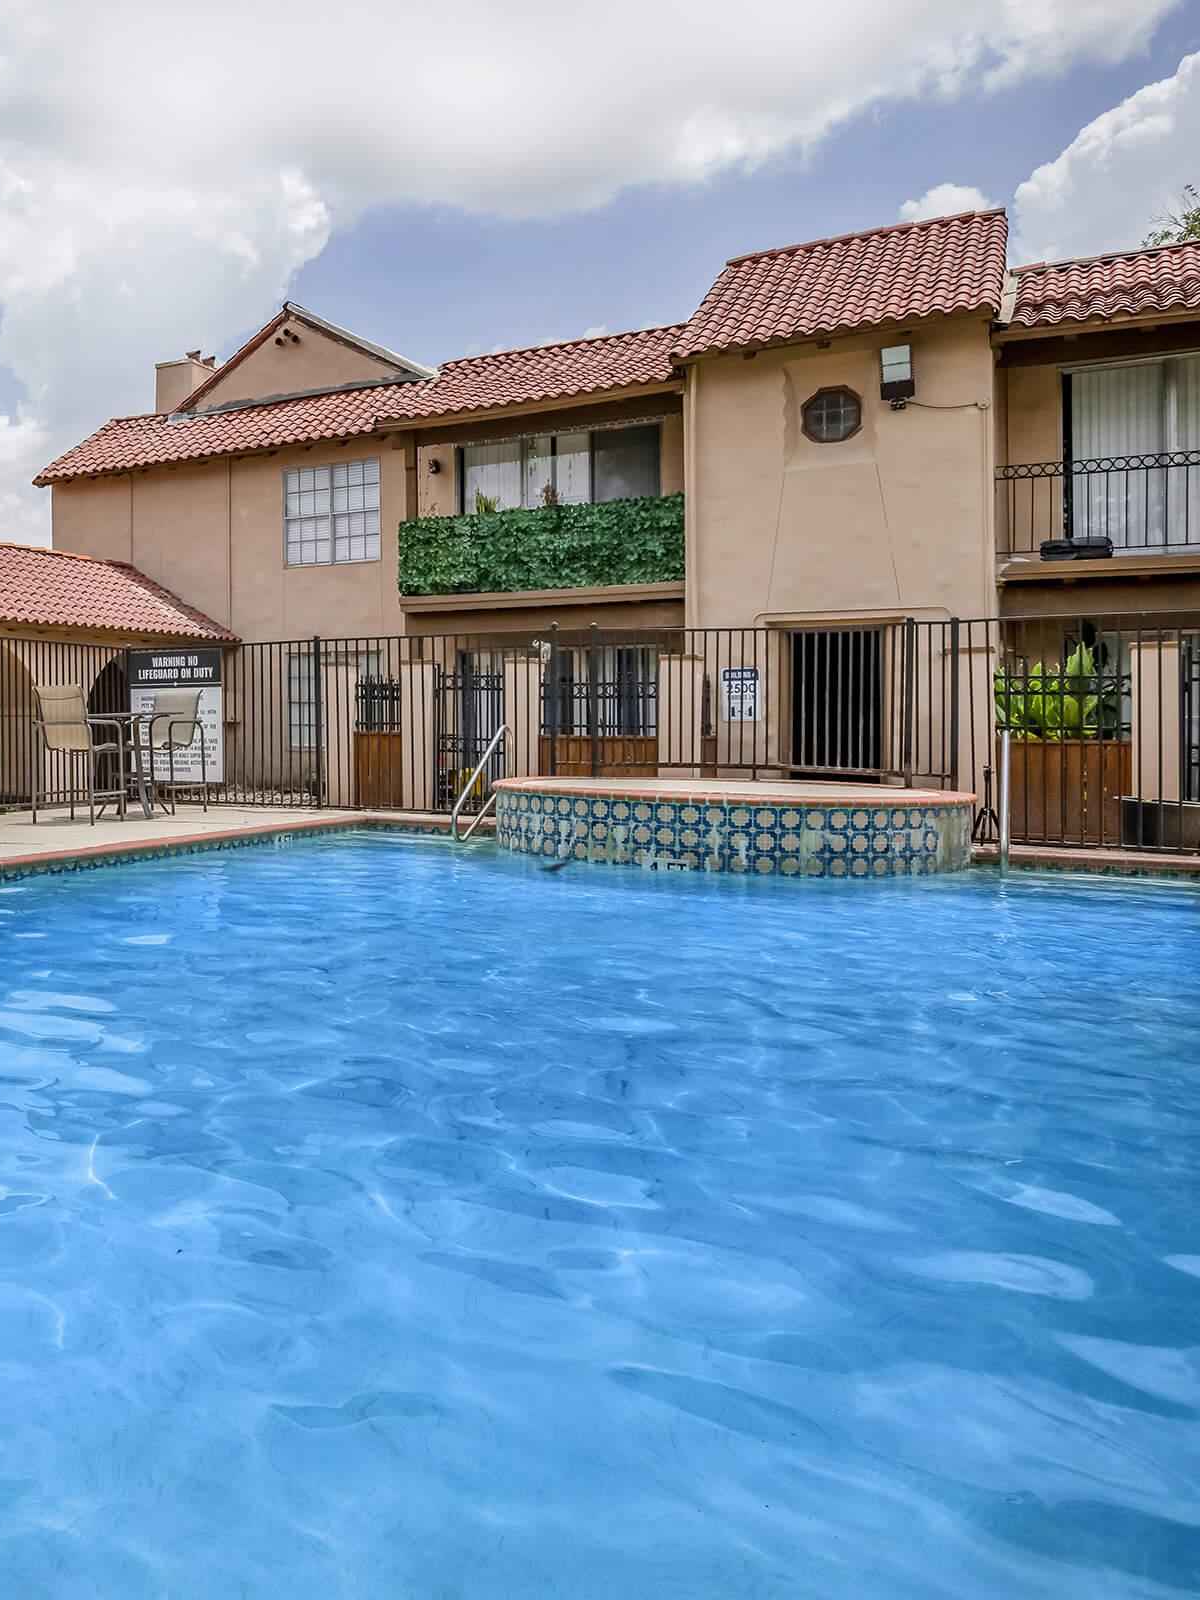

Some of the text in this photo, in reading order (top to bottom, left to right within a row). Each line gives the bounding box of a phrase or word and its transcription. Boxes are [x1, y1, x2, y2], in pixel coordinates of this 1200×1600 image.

[152, 655, 199, 668] WARNING NO
[138, 667, 214, 680] LIFEGUARD ON DUTY
